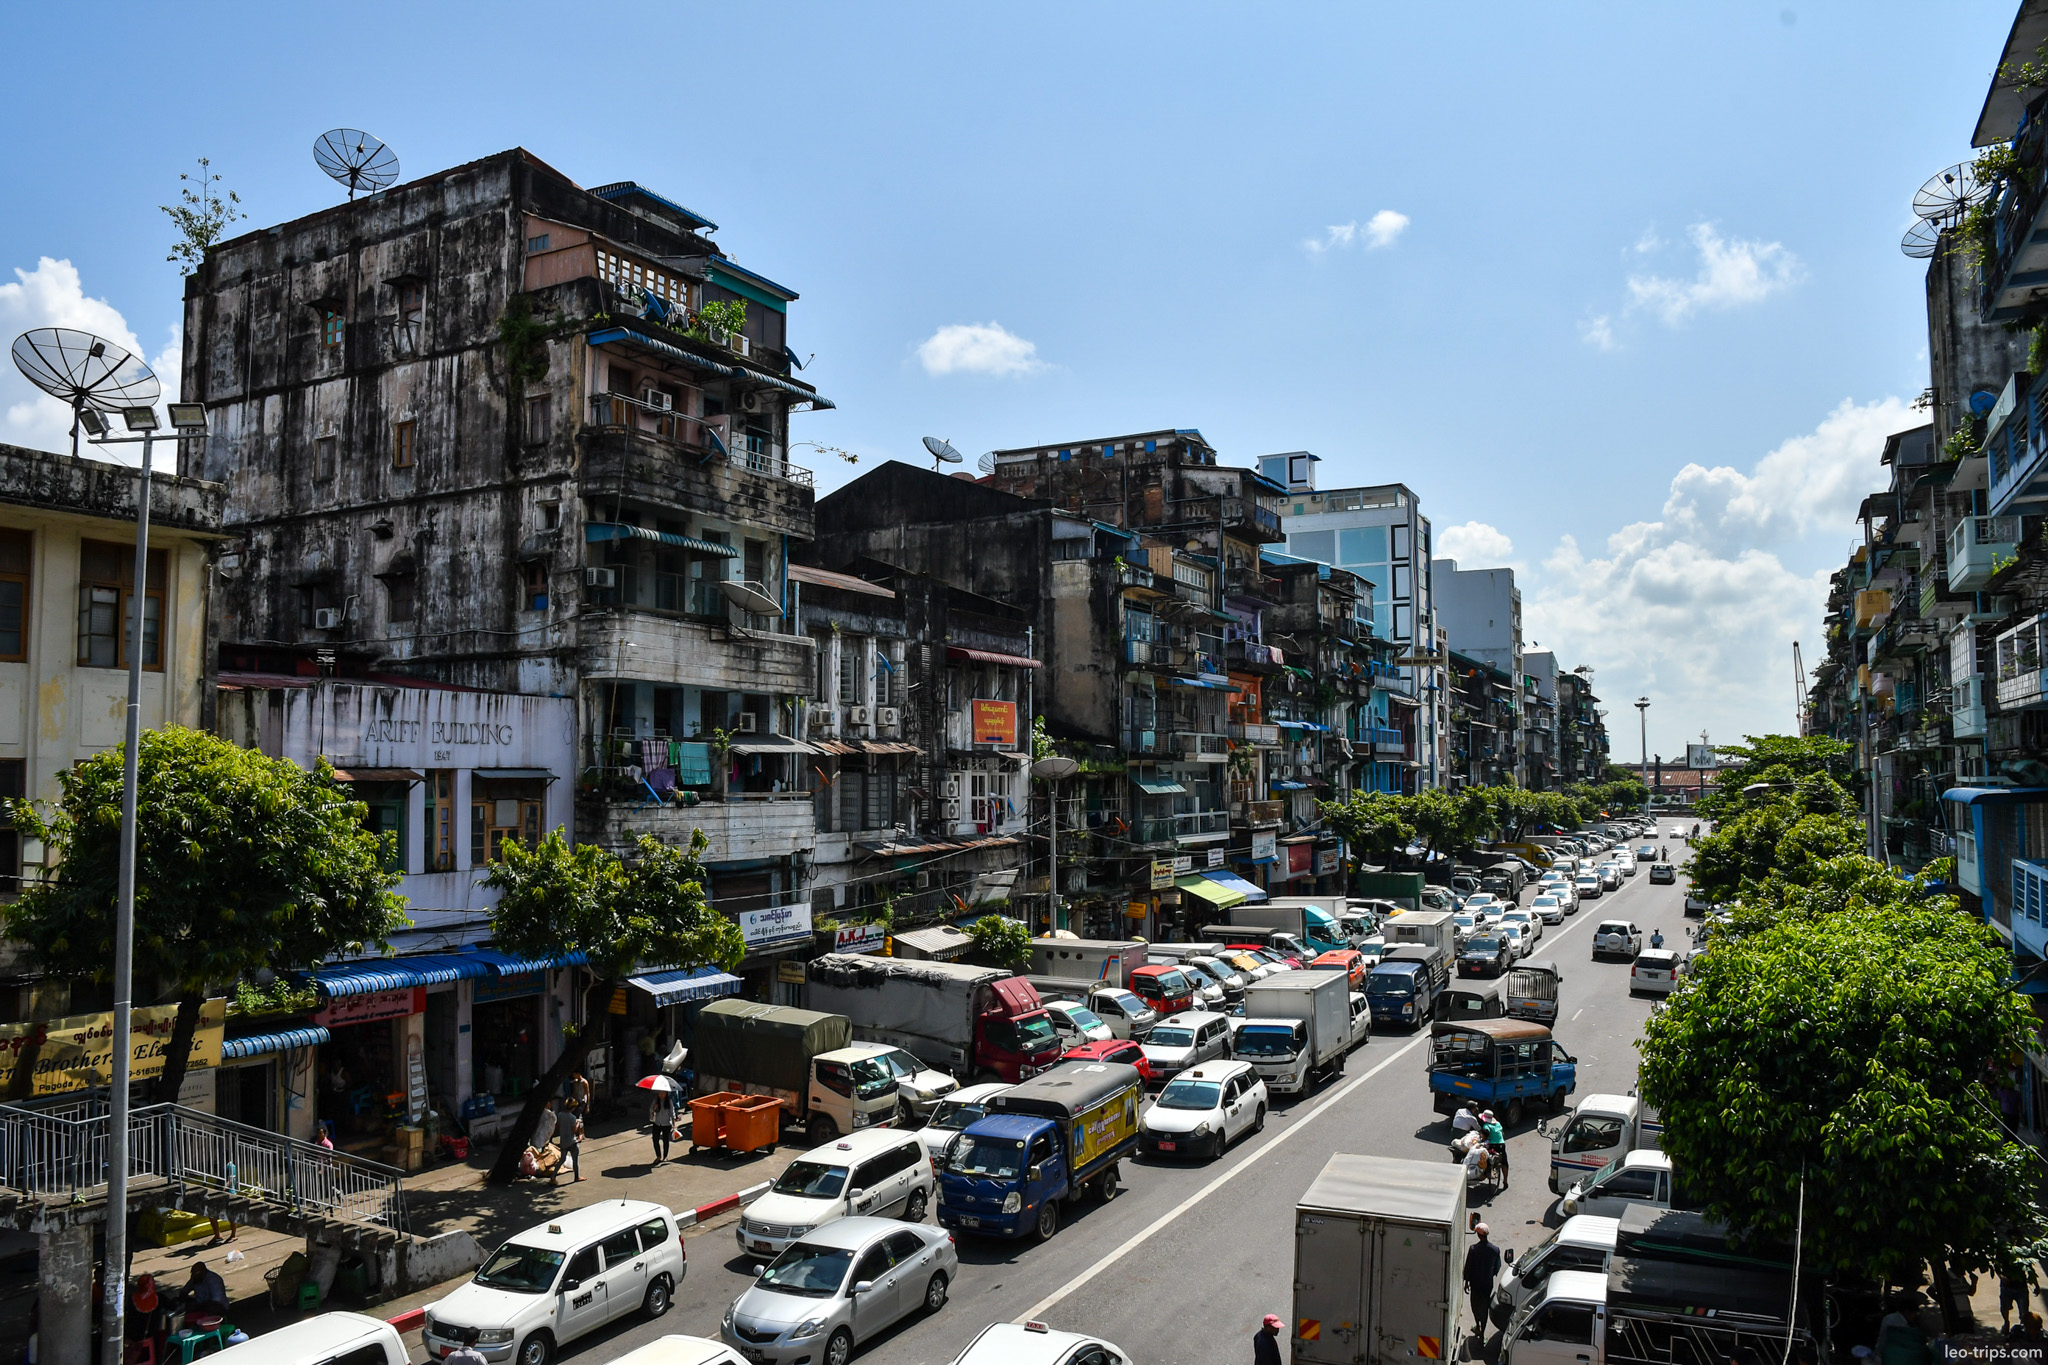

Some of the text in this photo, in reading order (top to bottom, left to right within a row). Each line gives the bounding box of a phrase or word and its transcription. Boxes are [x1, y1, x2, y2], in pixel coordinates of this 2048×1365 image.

[365, 719, 513, 746] ARIFF BUILDING
[433, 750, 451, 761] 1947
[34, 1050, 114, 1075] Brother
[134, 1037, 204, 1060] Eleic
[39, 1081, 74, 1092] Pagoda
[1026, 1322, 1043, 1330] TAXI
